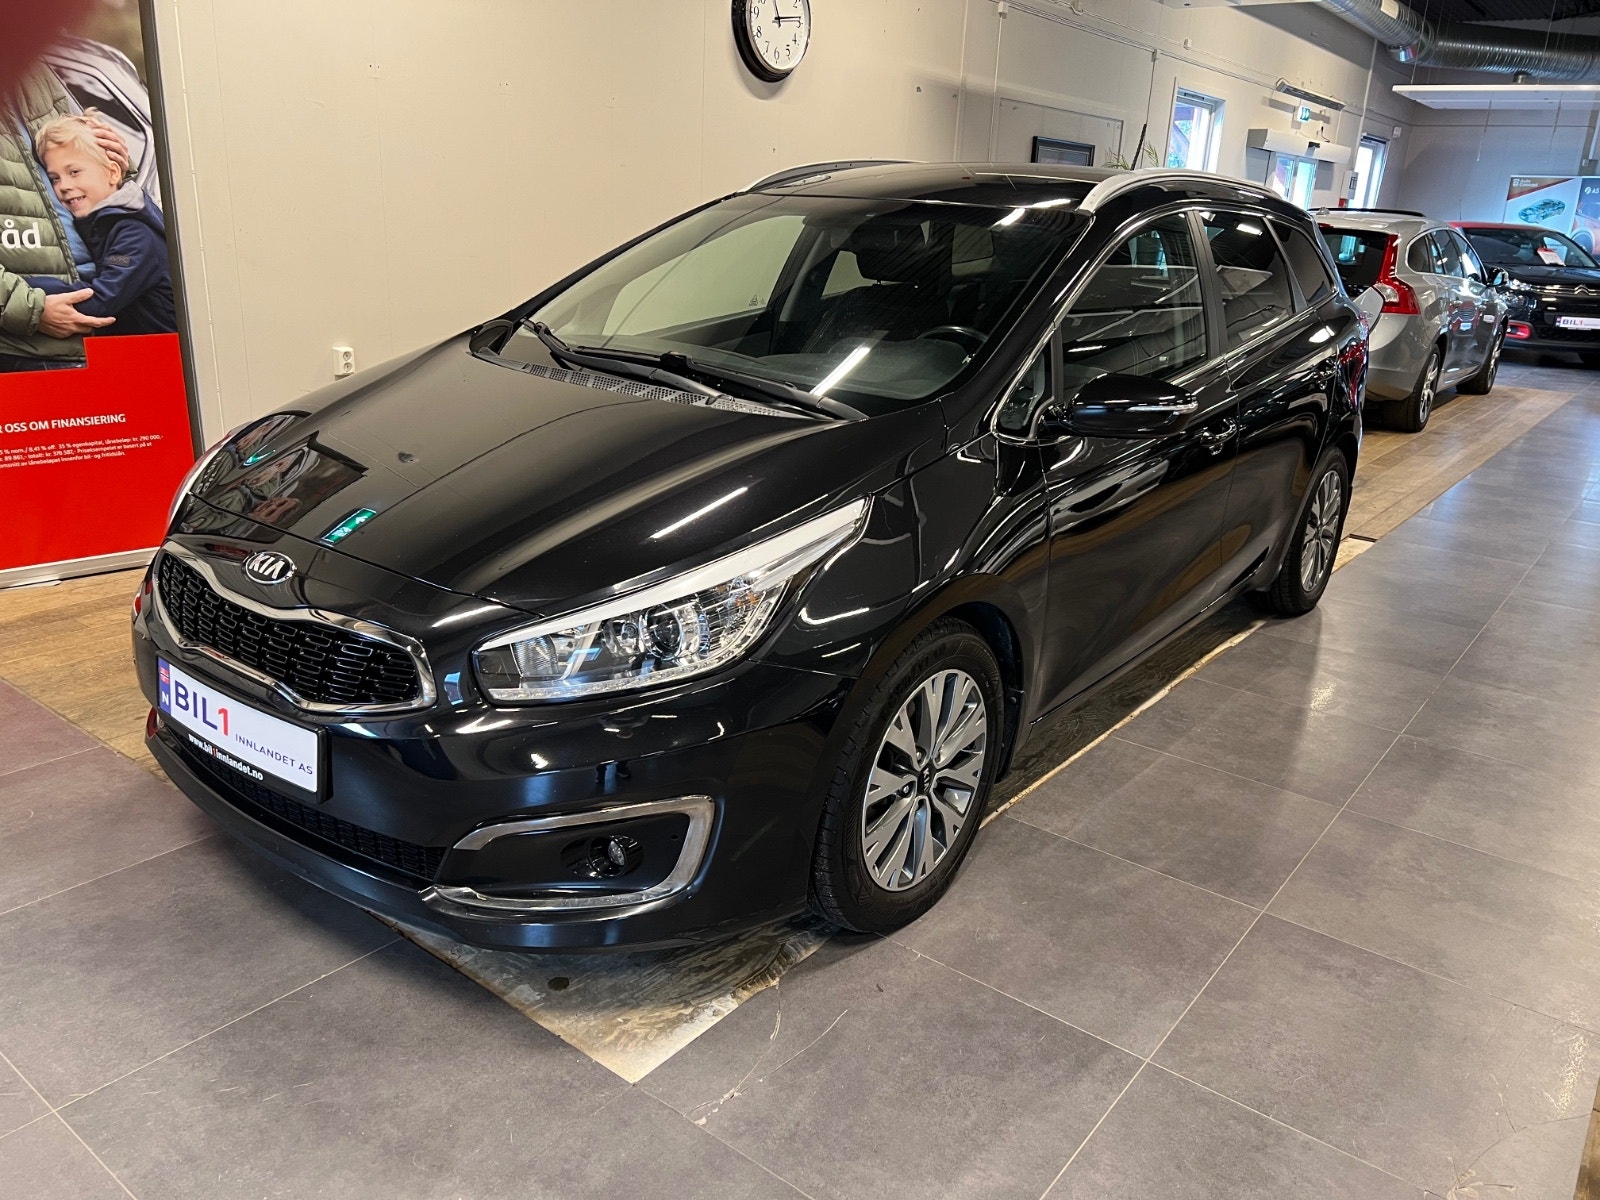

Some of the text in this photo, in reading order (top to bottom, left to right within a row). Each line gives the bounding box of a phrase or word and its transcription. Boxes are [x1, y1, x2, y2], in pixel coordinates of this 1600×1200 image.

[754, 6, 759, 19] 9
[756, 26, 762, 38] 8
[792, 32, 797, 44] 4
[765, 40, 770, 53] 7
[774, 46, 780, 60] 6
[786, 44, 790, 57] 5
[4, 422, 28, 433] OSS
[29, 420, 50, 431] OM
[51, 413, 126, 428] FINANSIERING
[248, 553, 285, 580] KIA
[161, 690, 170, 706] N
[174, 680, 314, 776] BIL1 INNLANDET AS
[188, 733, 265, 782] www.bil1innlandet.no
